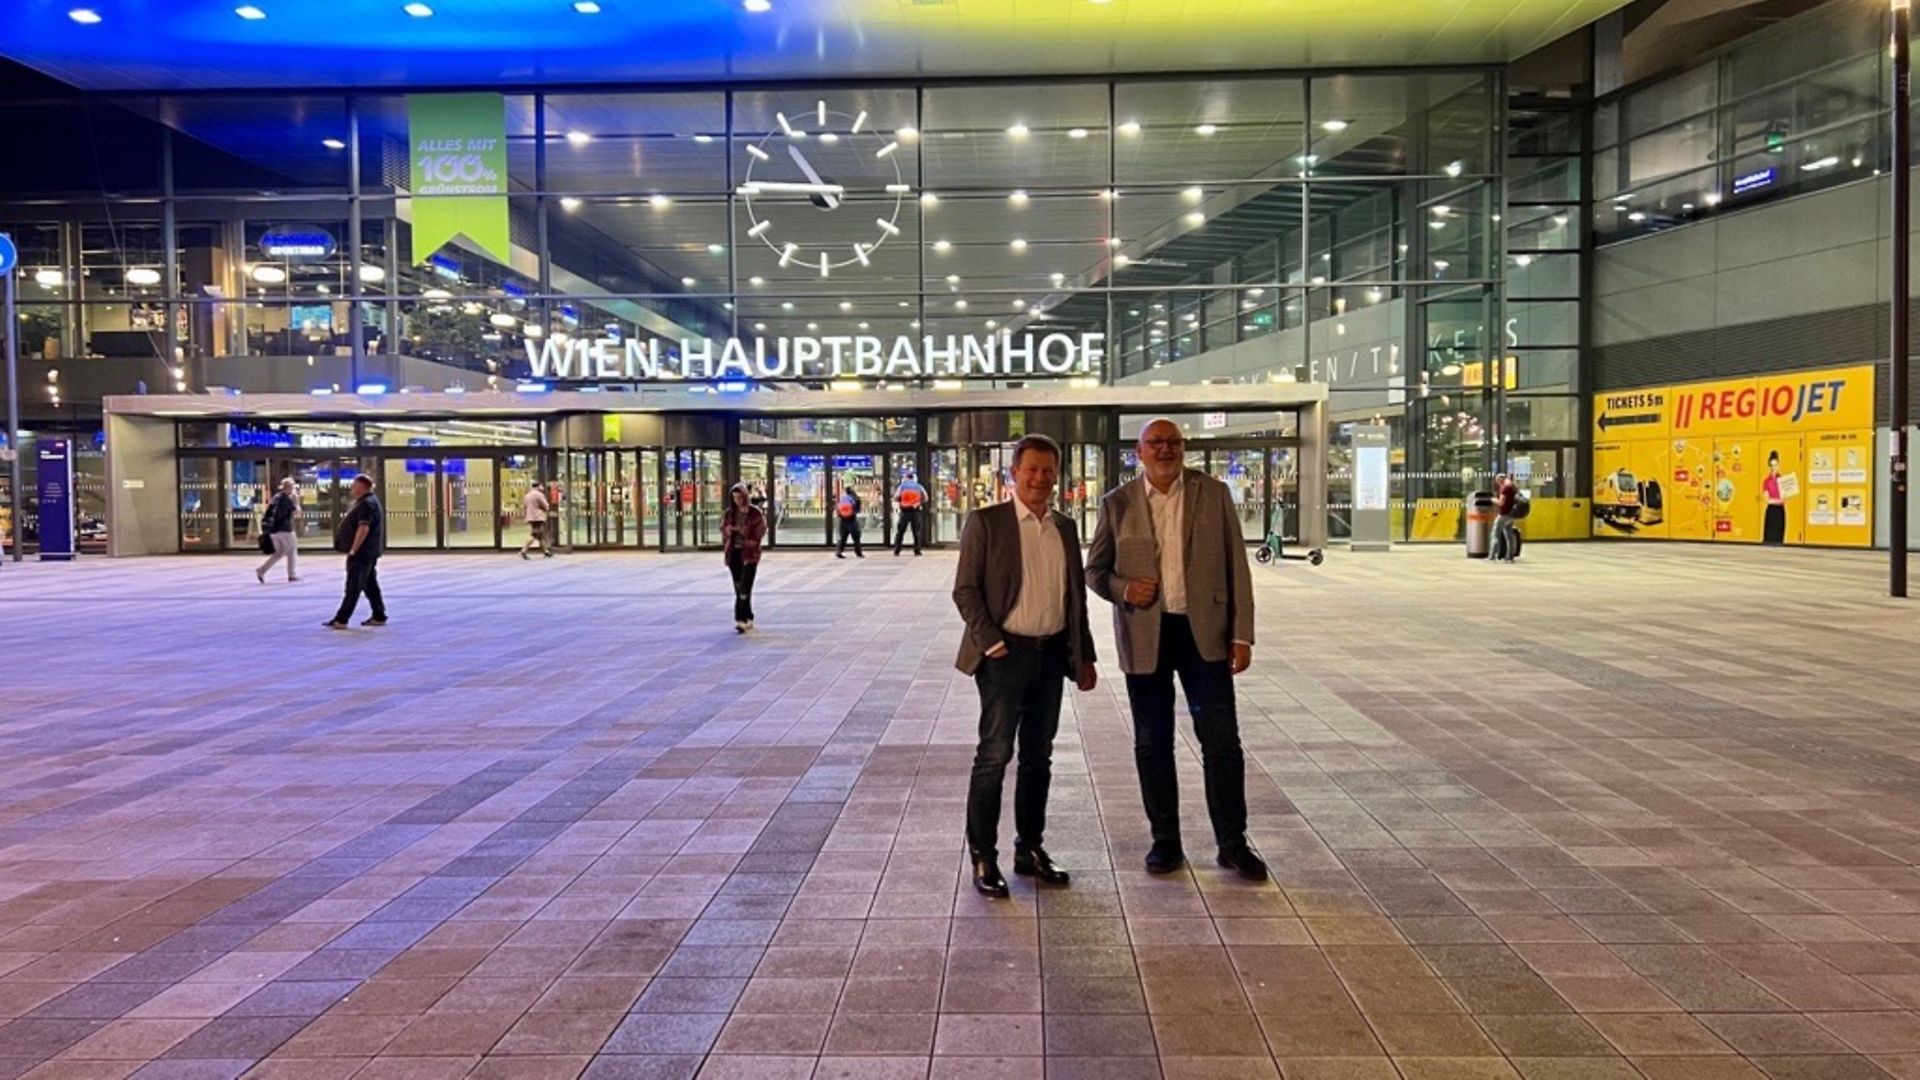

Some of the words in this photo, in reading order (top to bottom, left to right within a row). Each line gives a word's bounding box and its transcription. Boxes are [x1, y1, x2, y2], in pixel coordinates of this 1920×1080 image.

[418, 139, 462, 151] ALLES
[467, 138, 497, 151] MIT
[418, 154, 497, 182] 100%
[523, 337, 659, 377] WIEN
[679, 332, 1105, 377] HAUPTBAHNHOF
[1607, 394, 1645, 410] TICKETS
[1647, 393, 1663, 406] 5m
[1699, 380, 1846, 422] REGIOJET
